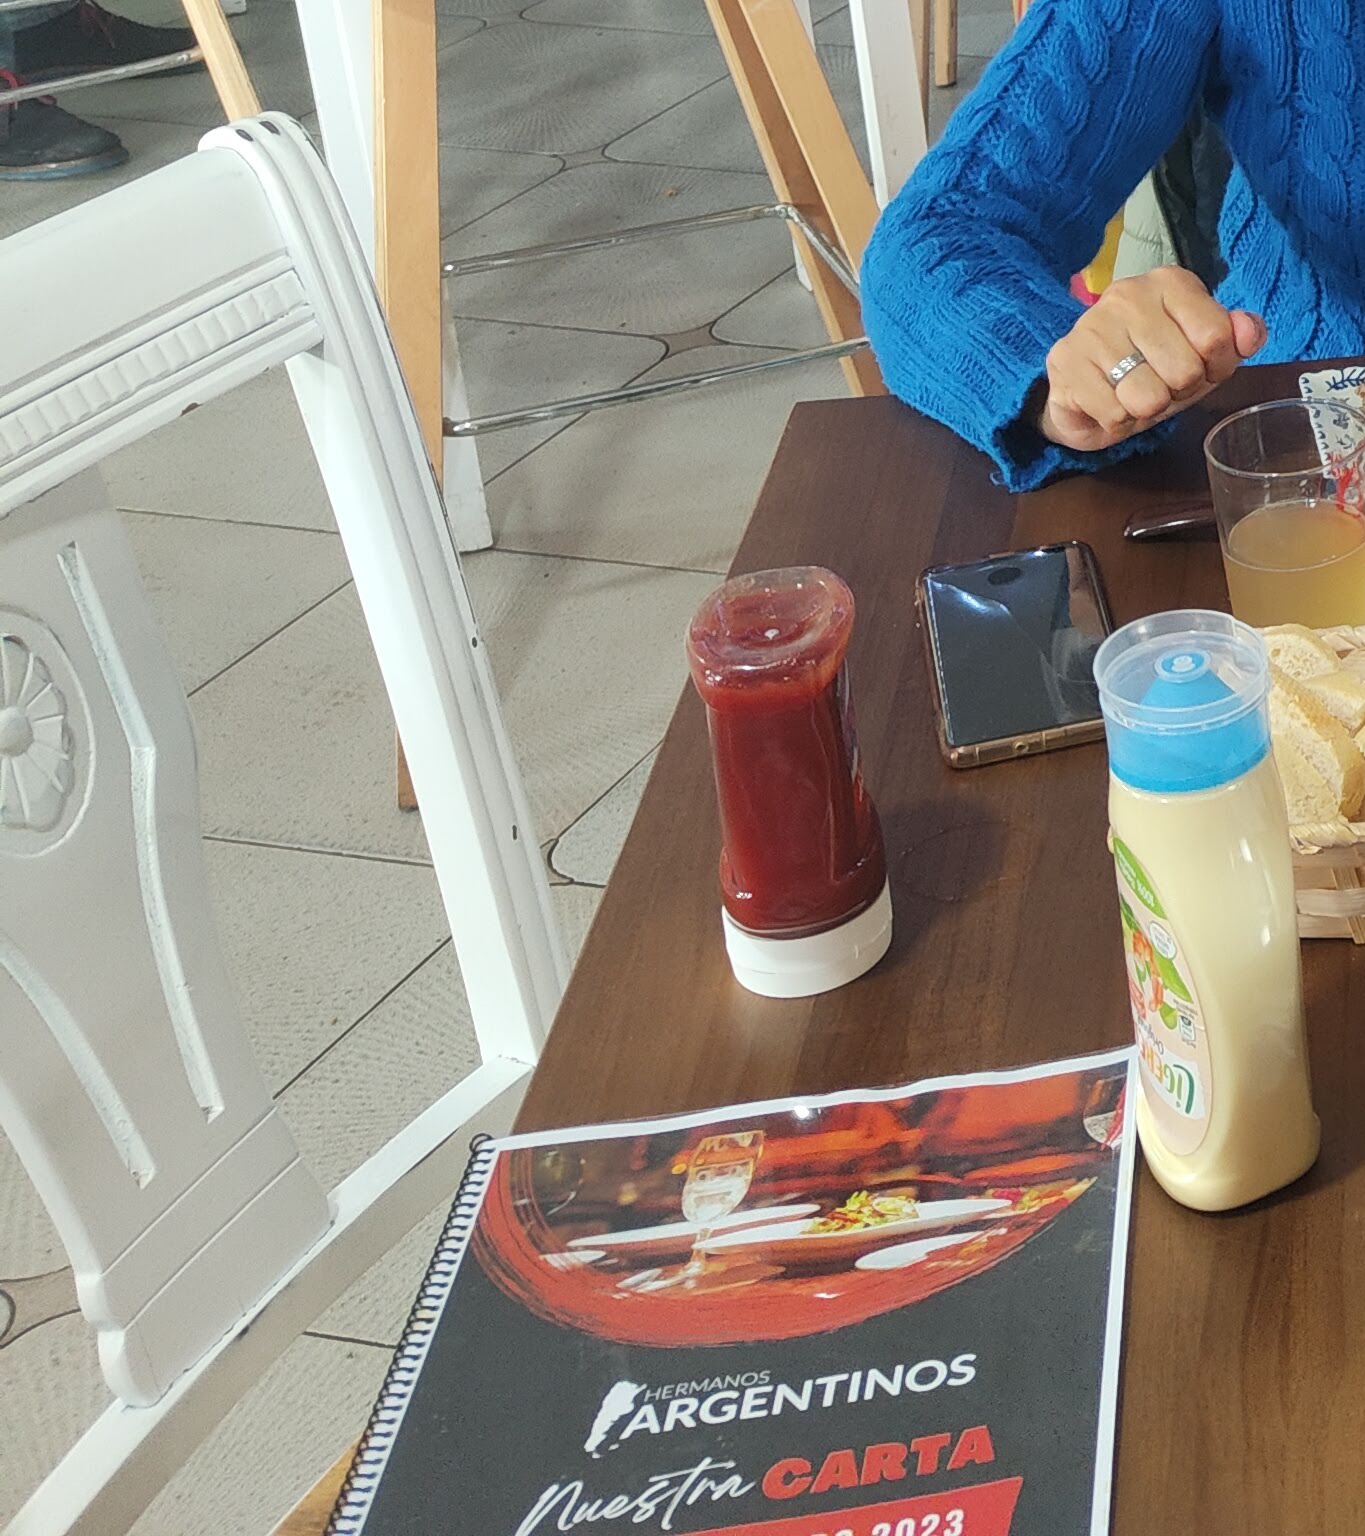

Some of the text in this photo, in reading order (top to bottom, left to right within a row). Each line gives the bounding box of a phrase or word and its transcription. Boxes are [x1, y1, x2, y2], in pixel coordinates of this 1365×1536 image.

[621, 1353, 978, 1440] ARGENTINOS
[643, 1370, 771, 1402] HERMANOS
[762, 1425, 996, 1500] CARTA
[870, 1509, 964, 1536] 2023
